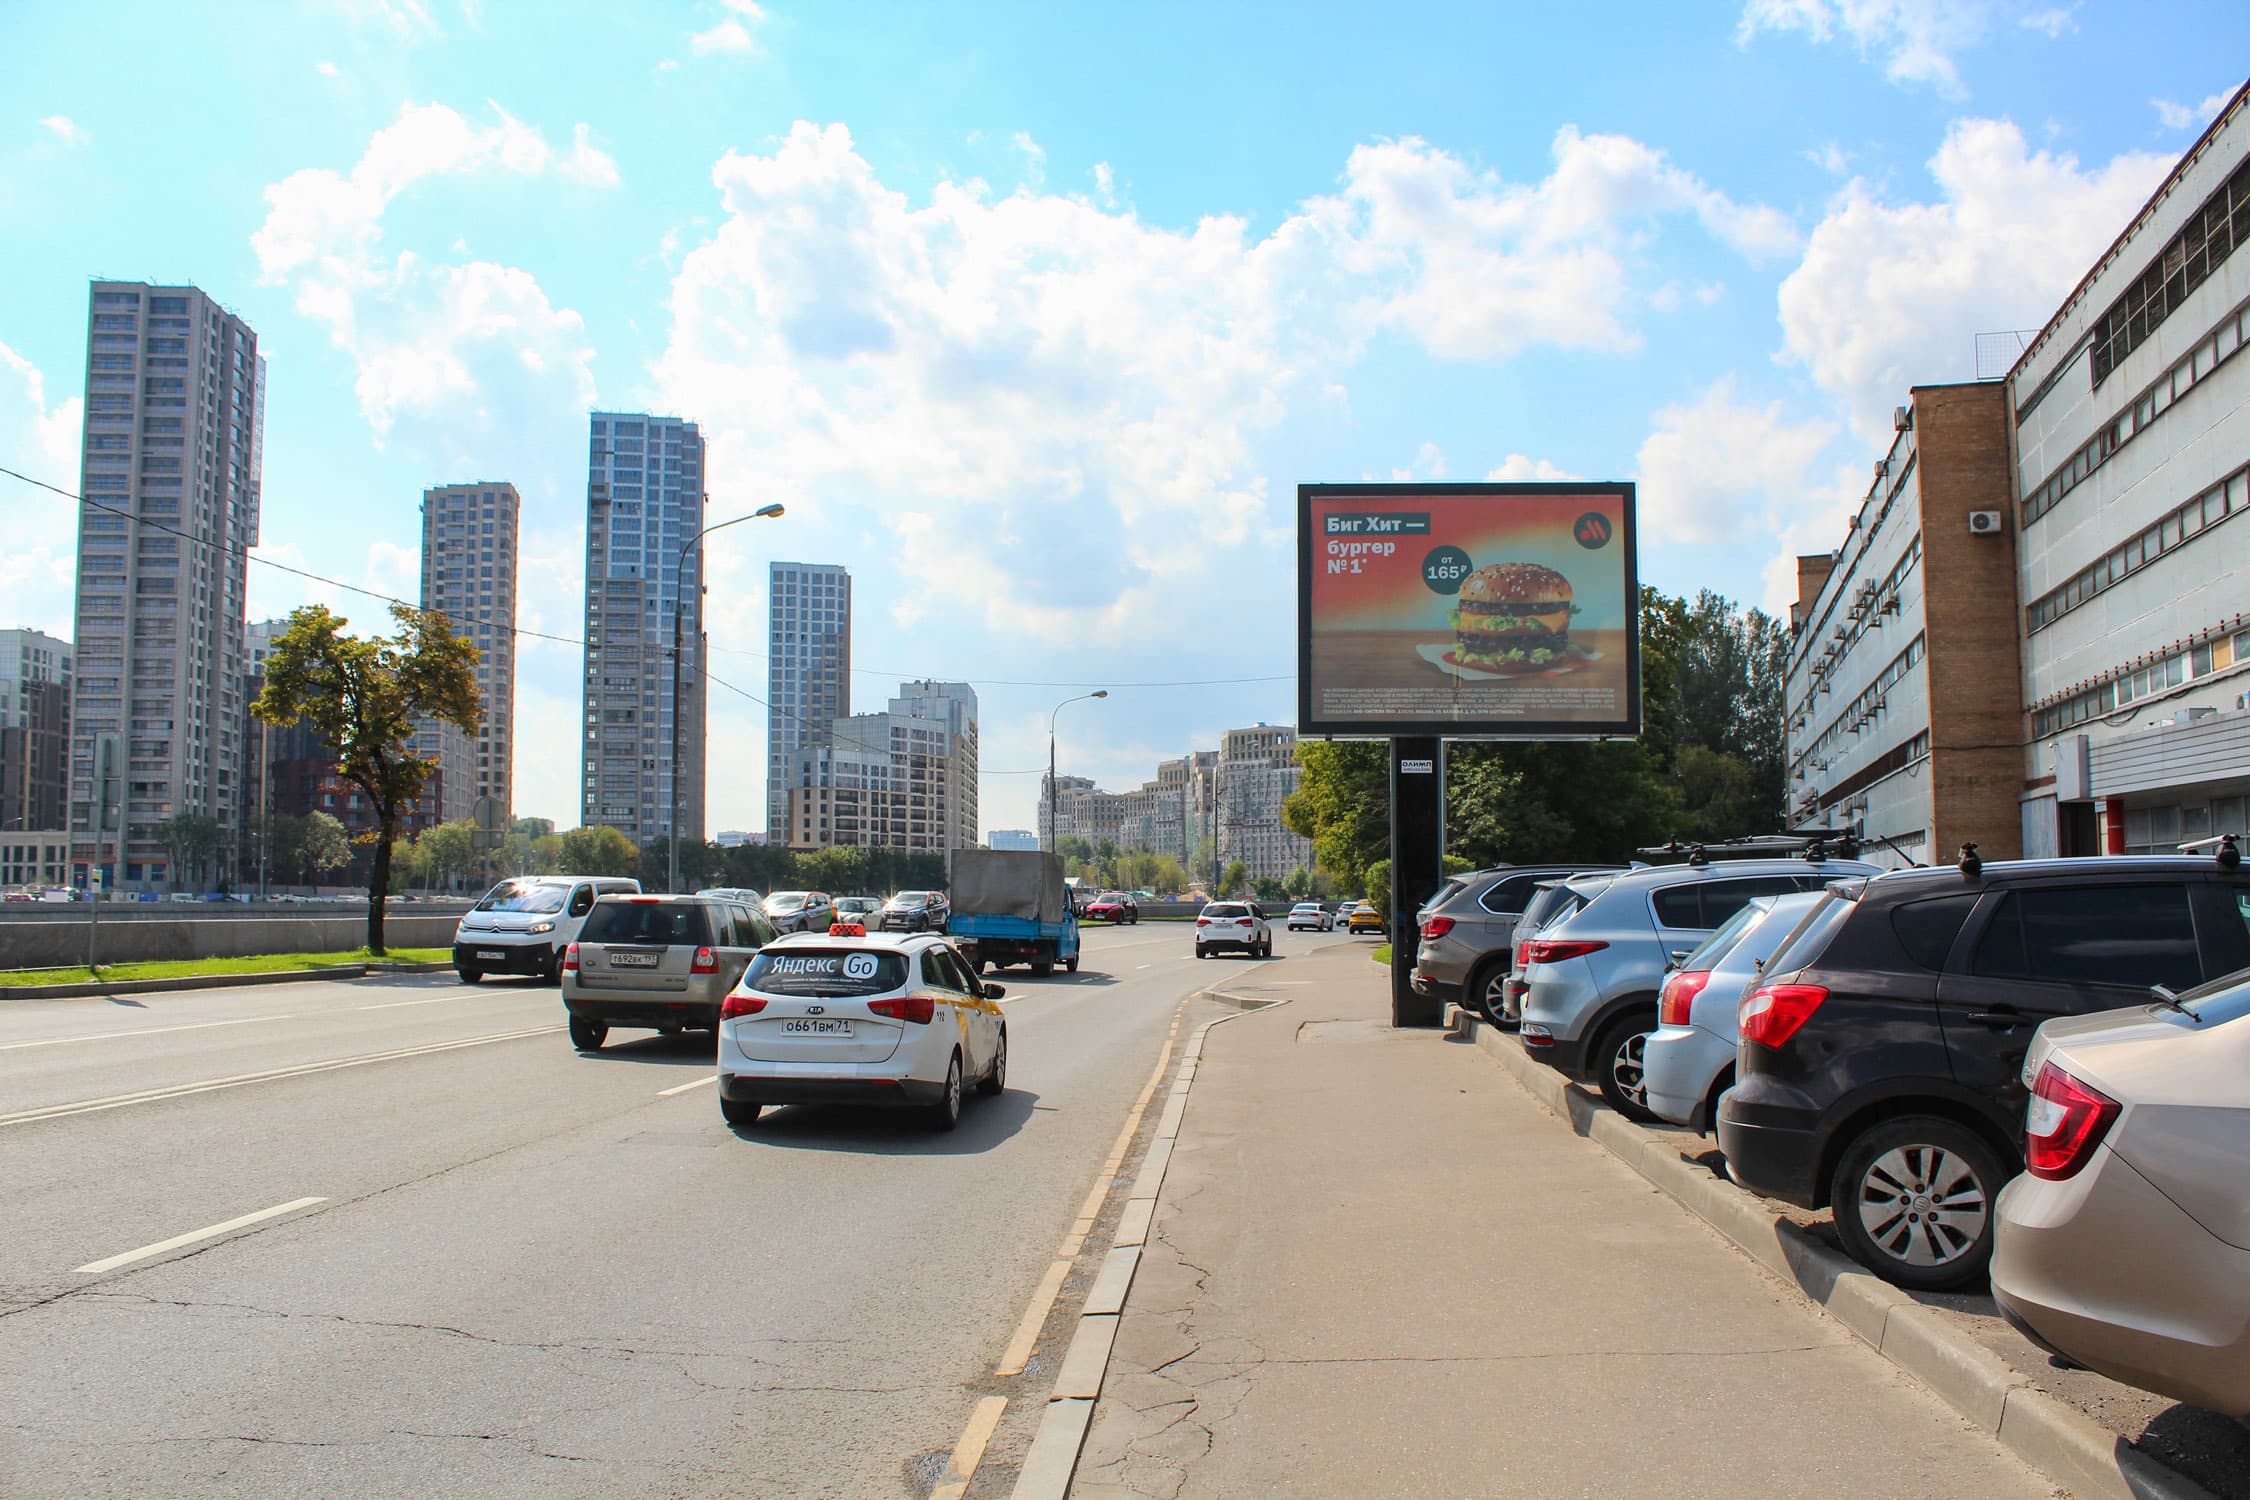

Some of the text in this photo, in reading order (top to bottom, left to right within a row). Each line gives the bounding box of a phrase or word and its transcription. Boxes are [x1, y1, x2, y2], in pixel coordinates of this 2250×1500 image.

[1327, 517, 1362, 532] Биг
[1366, 517, 1402, 531] Хит
[1327, 540, 1396, 557] бургер
[771, 956, 837, 975] Яндекс
[848, 956, 872, 975] Go
